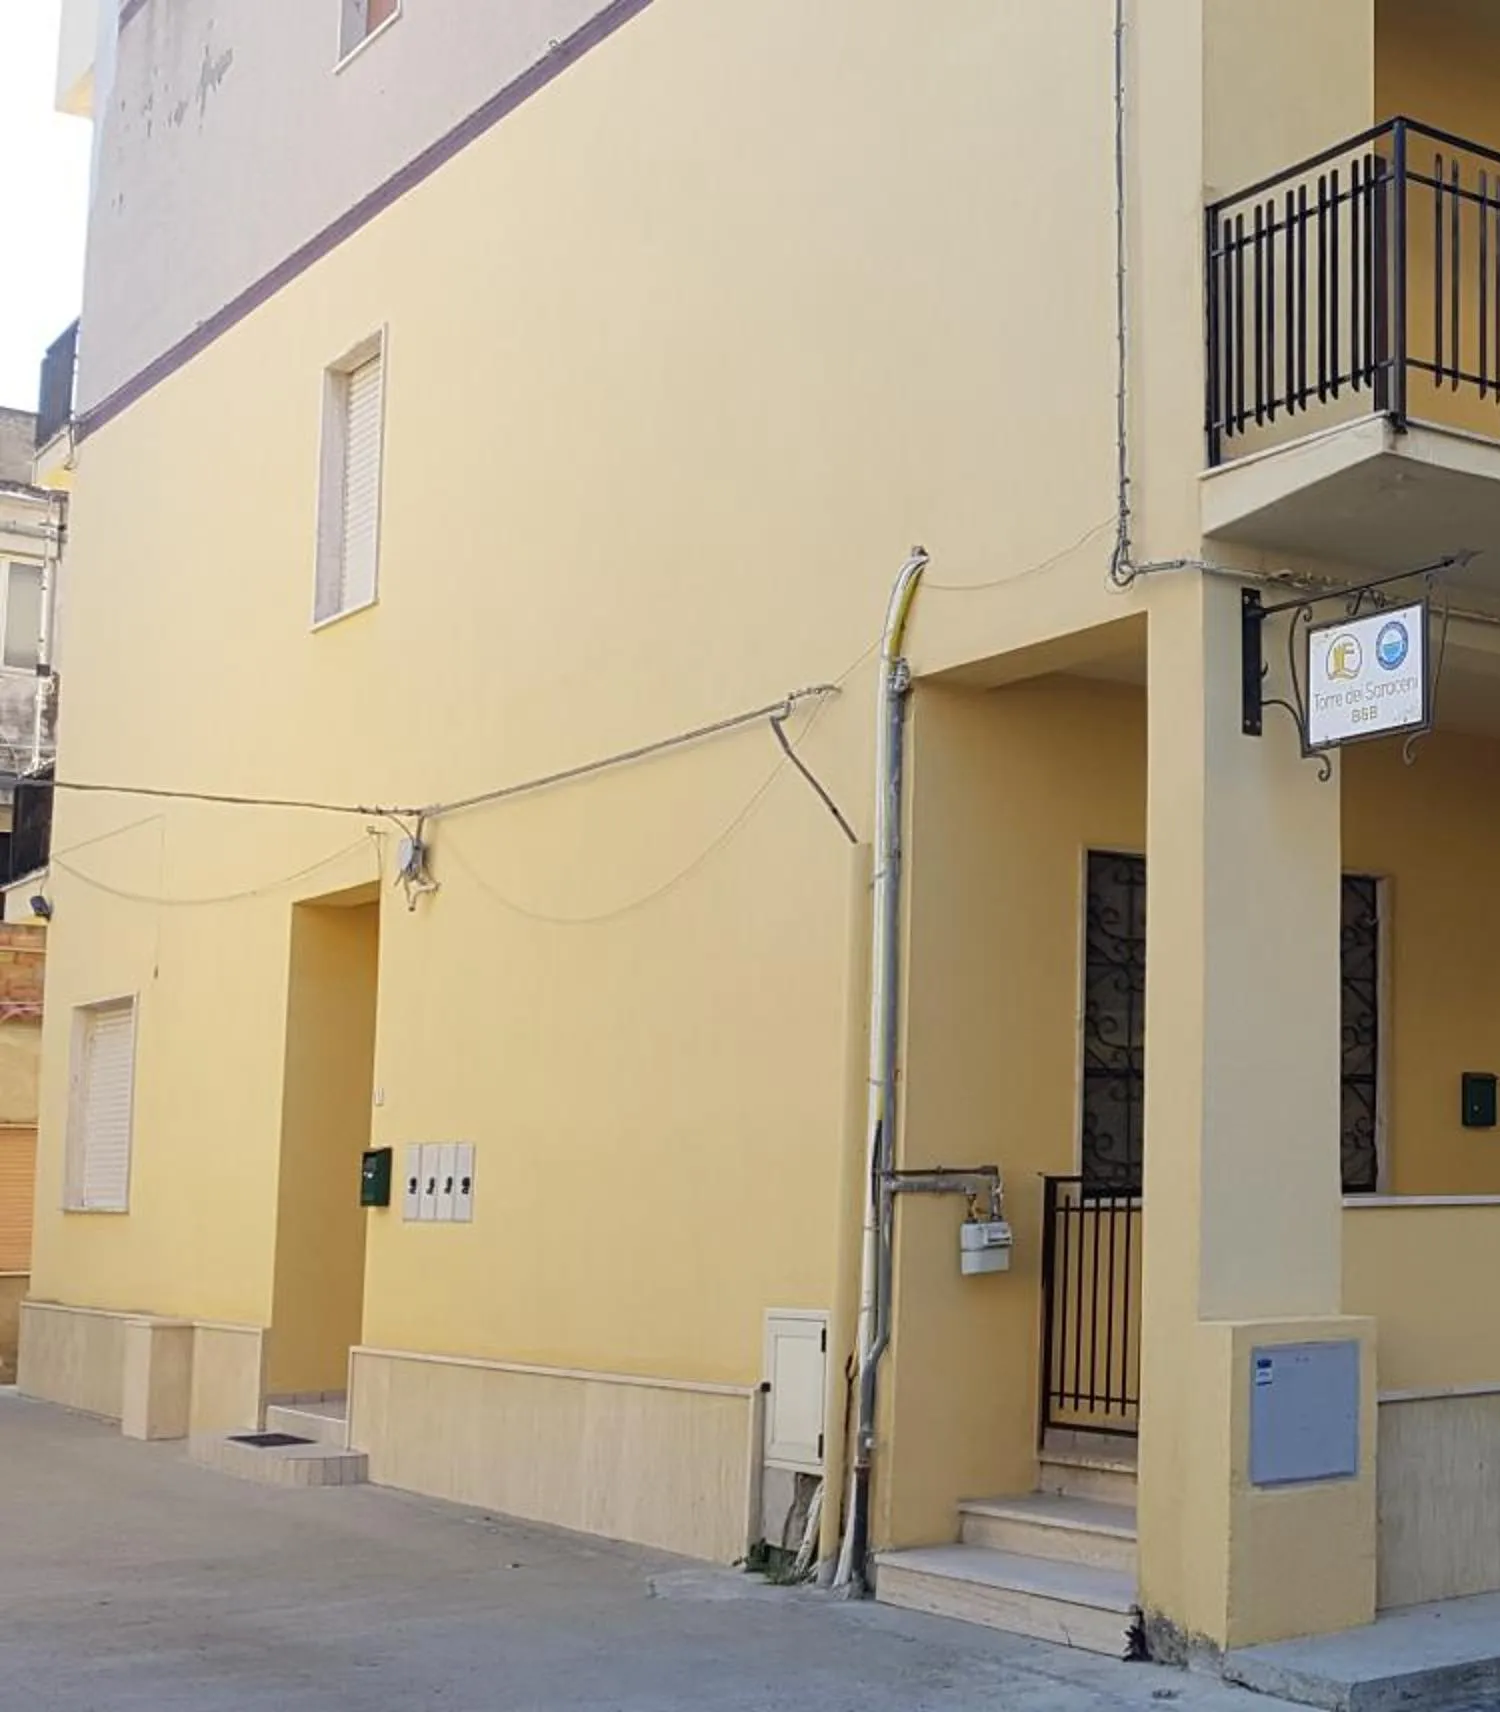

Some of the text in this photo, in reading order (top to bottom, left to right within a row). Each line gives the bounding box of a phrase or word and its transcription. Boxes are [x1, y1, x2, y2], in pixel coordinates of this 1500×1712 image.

[1314, 692, 1343, 711] Torre
[1345, 682, 1364, 704] dei
[1351, 705, 1378, 723] B&B
